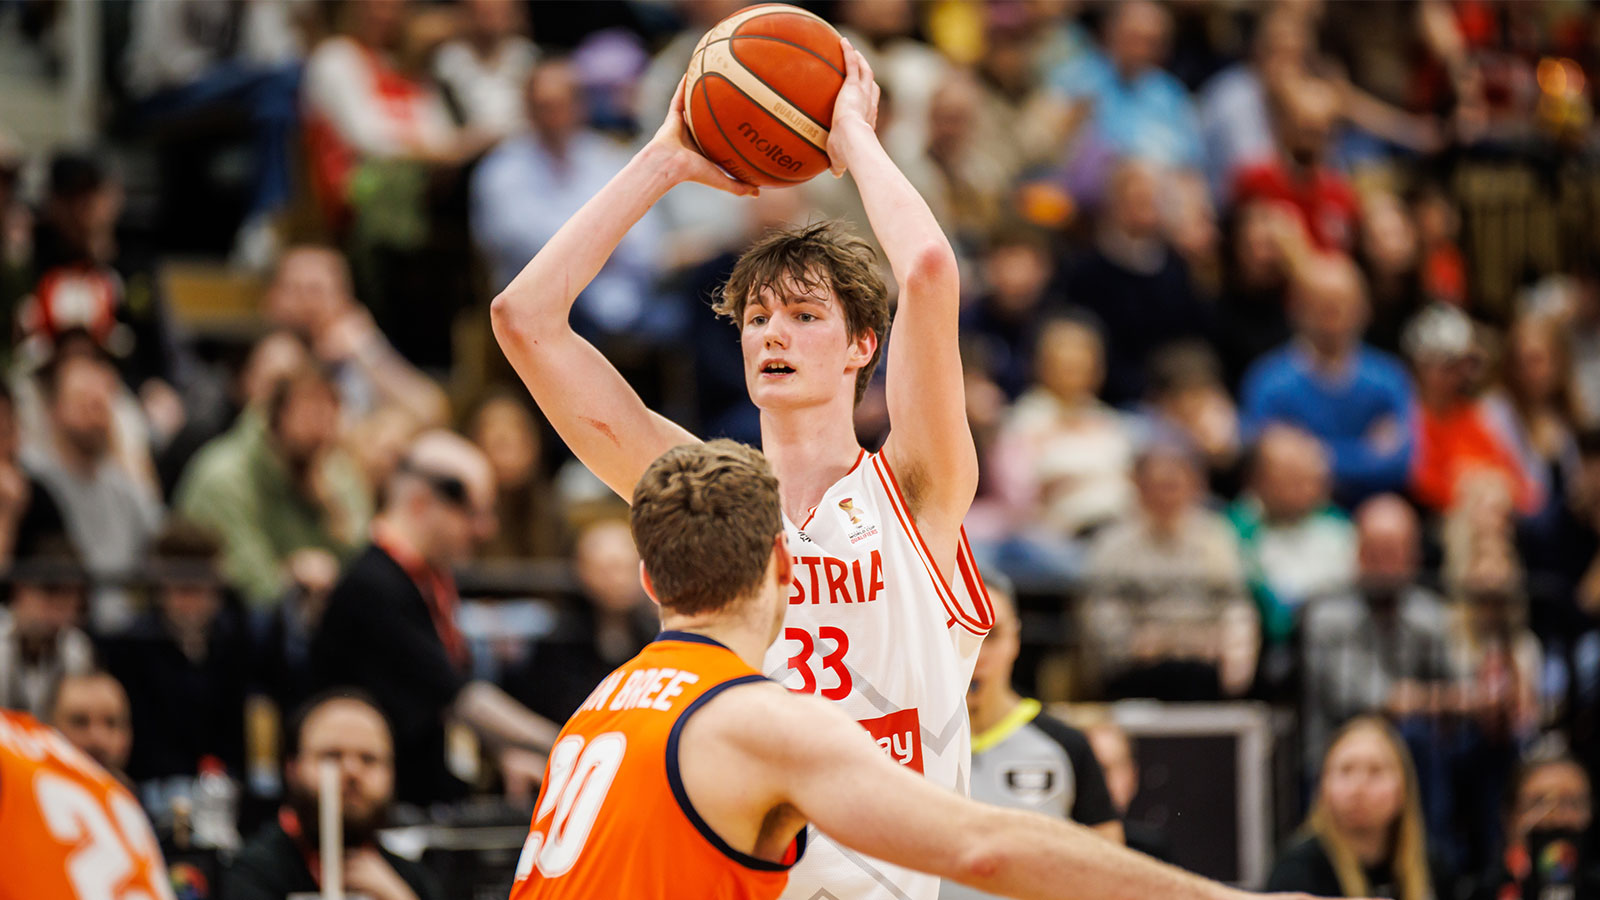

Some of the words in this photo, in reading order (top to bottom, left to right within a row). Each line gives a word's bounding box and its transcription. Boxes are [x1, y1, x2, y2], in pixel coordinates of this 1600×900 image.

[773, 102, 819, 138] QUALIFIERS
[737, 121, 803, 172] molten
[785, 626, 853, 701] 33
[608, 668, 700, 712] BREE
[867, 730, 914, 766] ay
